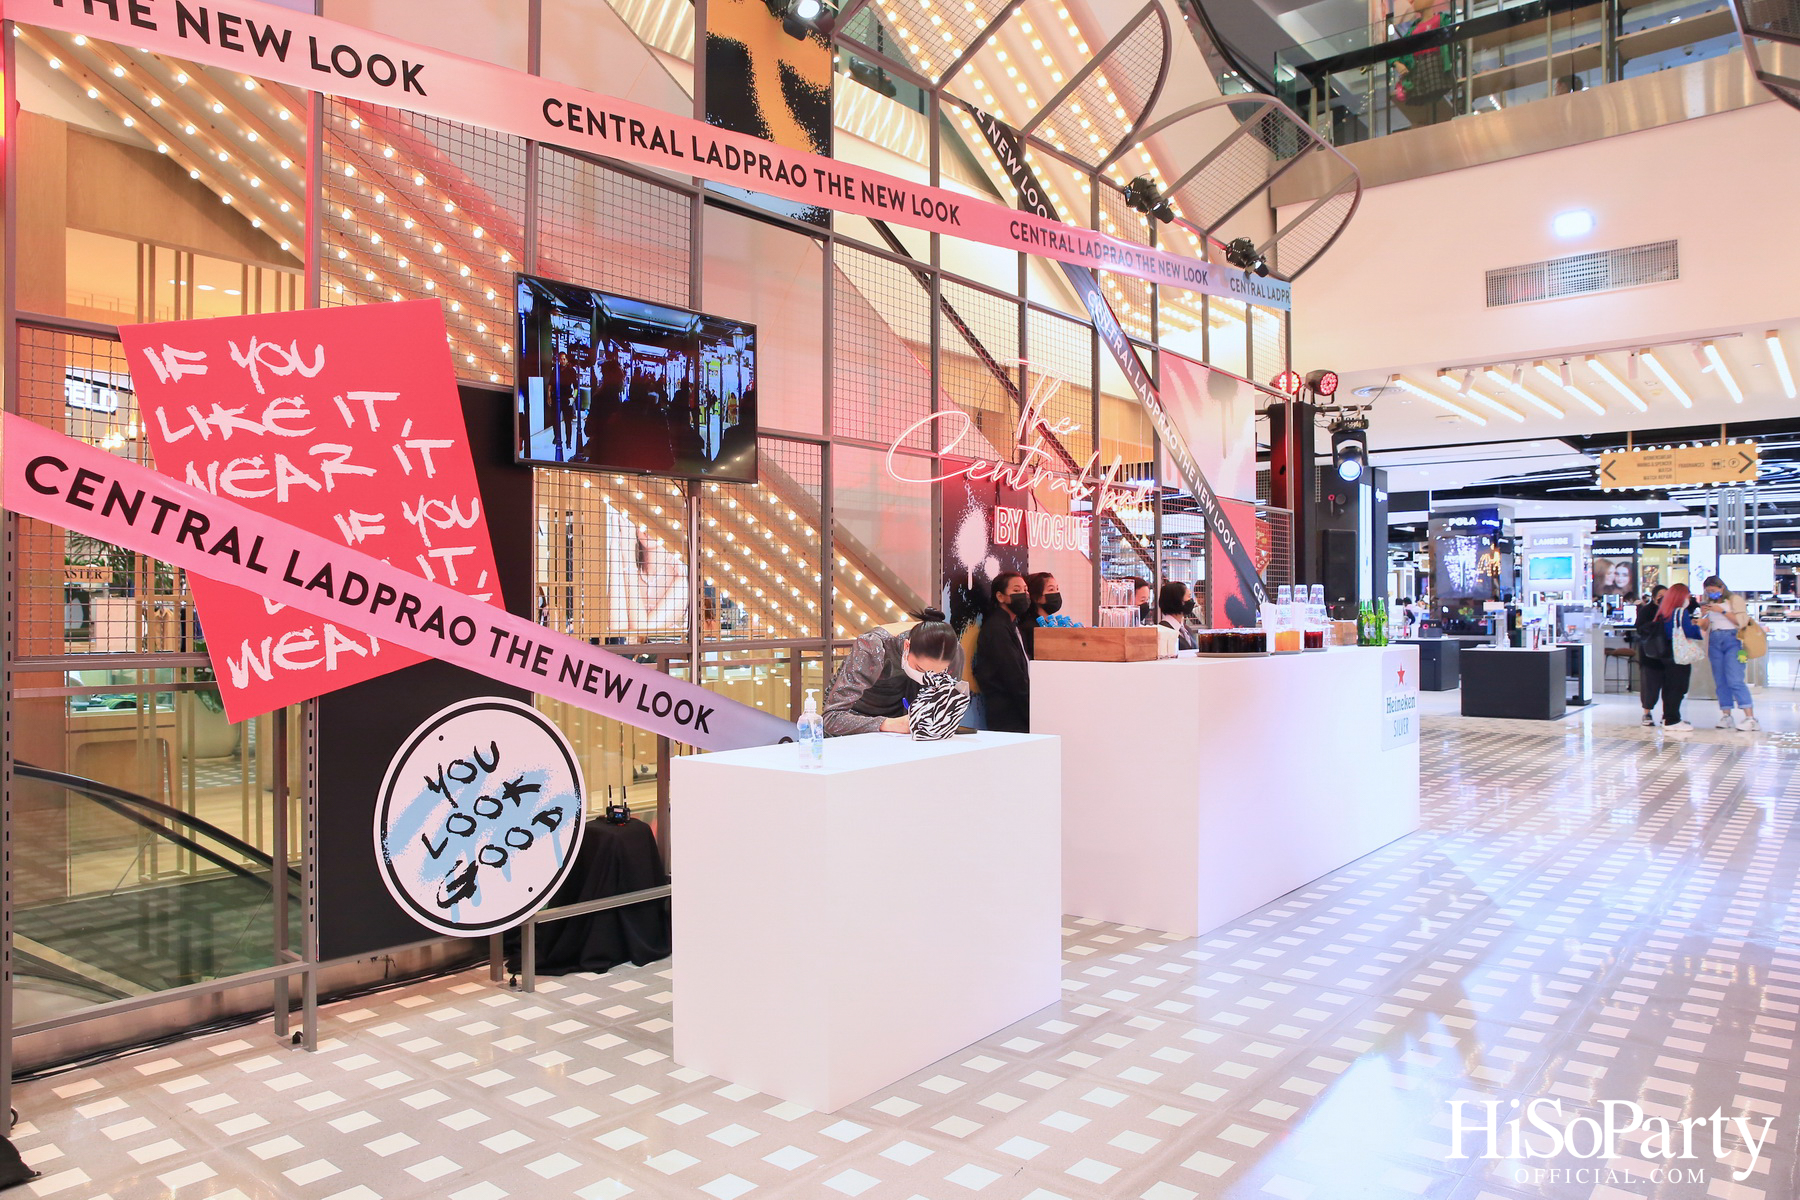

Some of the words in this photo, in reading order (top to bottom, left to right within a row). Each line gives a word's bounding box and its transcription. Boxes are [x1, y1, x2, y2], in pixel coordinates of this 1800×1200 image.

[175, 0, 292, 62] NEW
[309, 36, 427, 96] LOOK
[542, 98, 684, 158] CENTRAL
[692, 135, 807, 188] LADPRAO
[814, 168, 855, 200] THE
[861, 180, 906, 212] NEW
[911, 198, 961, 227] LOOK
[987, 120, 1022, 175] NEW
[1020, 175, 1055, 221] LOO
[1010, 220, 1075, 254] CENTRAL
[1078, 238, 1133, 268] LADPRAO
[1135, 253, 1156, 275] THE
[1158, 259, 1181, 279] NEW
[1183, 265, 1209, 286] LOOK
[1230, 277, 1265, 299] CENTRAL
[143, 343, 209, 384] IF
[228, 335, 326, 395] YOU
[155, 395, 316, 443] LIKE
[1004, 358, 1081, 441] The
[392, 438, 455, 479] IT
[886, 410, 1101, 503] Central
[1134, 371, 1178, 451] LADPRAO
[1178, 445, 1196, 482] THE
[1195, 476, 1216, 515] NEW
[1213, 509, 1236, 555] LOOK
[334, 509, 386, 546] IF
[401, 495, 480, 548] YOU
[994, 505, 1024, 545] BY
[1026, 510, 1091, 551] VOGUE
[1448, 517, 1477, 526] POLA
[1610, 517, 1644, 527] POLA
[1647, 531, 1683, 539] LANEIGE
[25, 456, 267, 574] CENTRAL
[283, 550, 477, 647] LADPRAO
[489, 625, 554, 677] THE
[558, 654, 633, 704] NEW
[637, 684, 714, 735] LOOK
[226, 622, 381, 690] WEA
[1386, 694, 1416, 714] Heineken
[1393, 717, 1409, 737] SILVER
[424, 741, 500, 809] YOU
[422, 775, 541, 860] LOOK
[437, 806, 564, 909] GOOD
